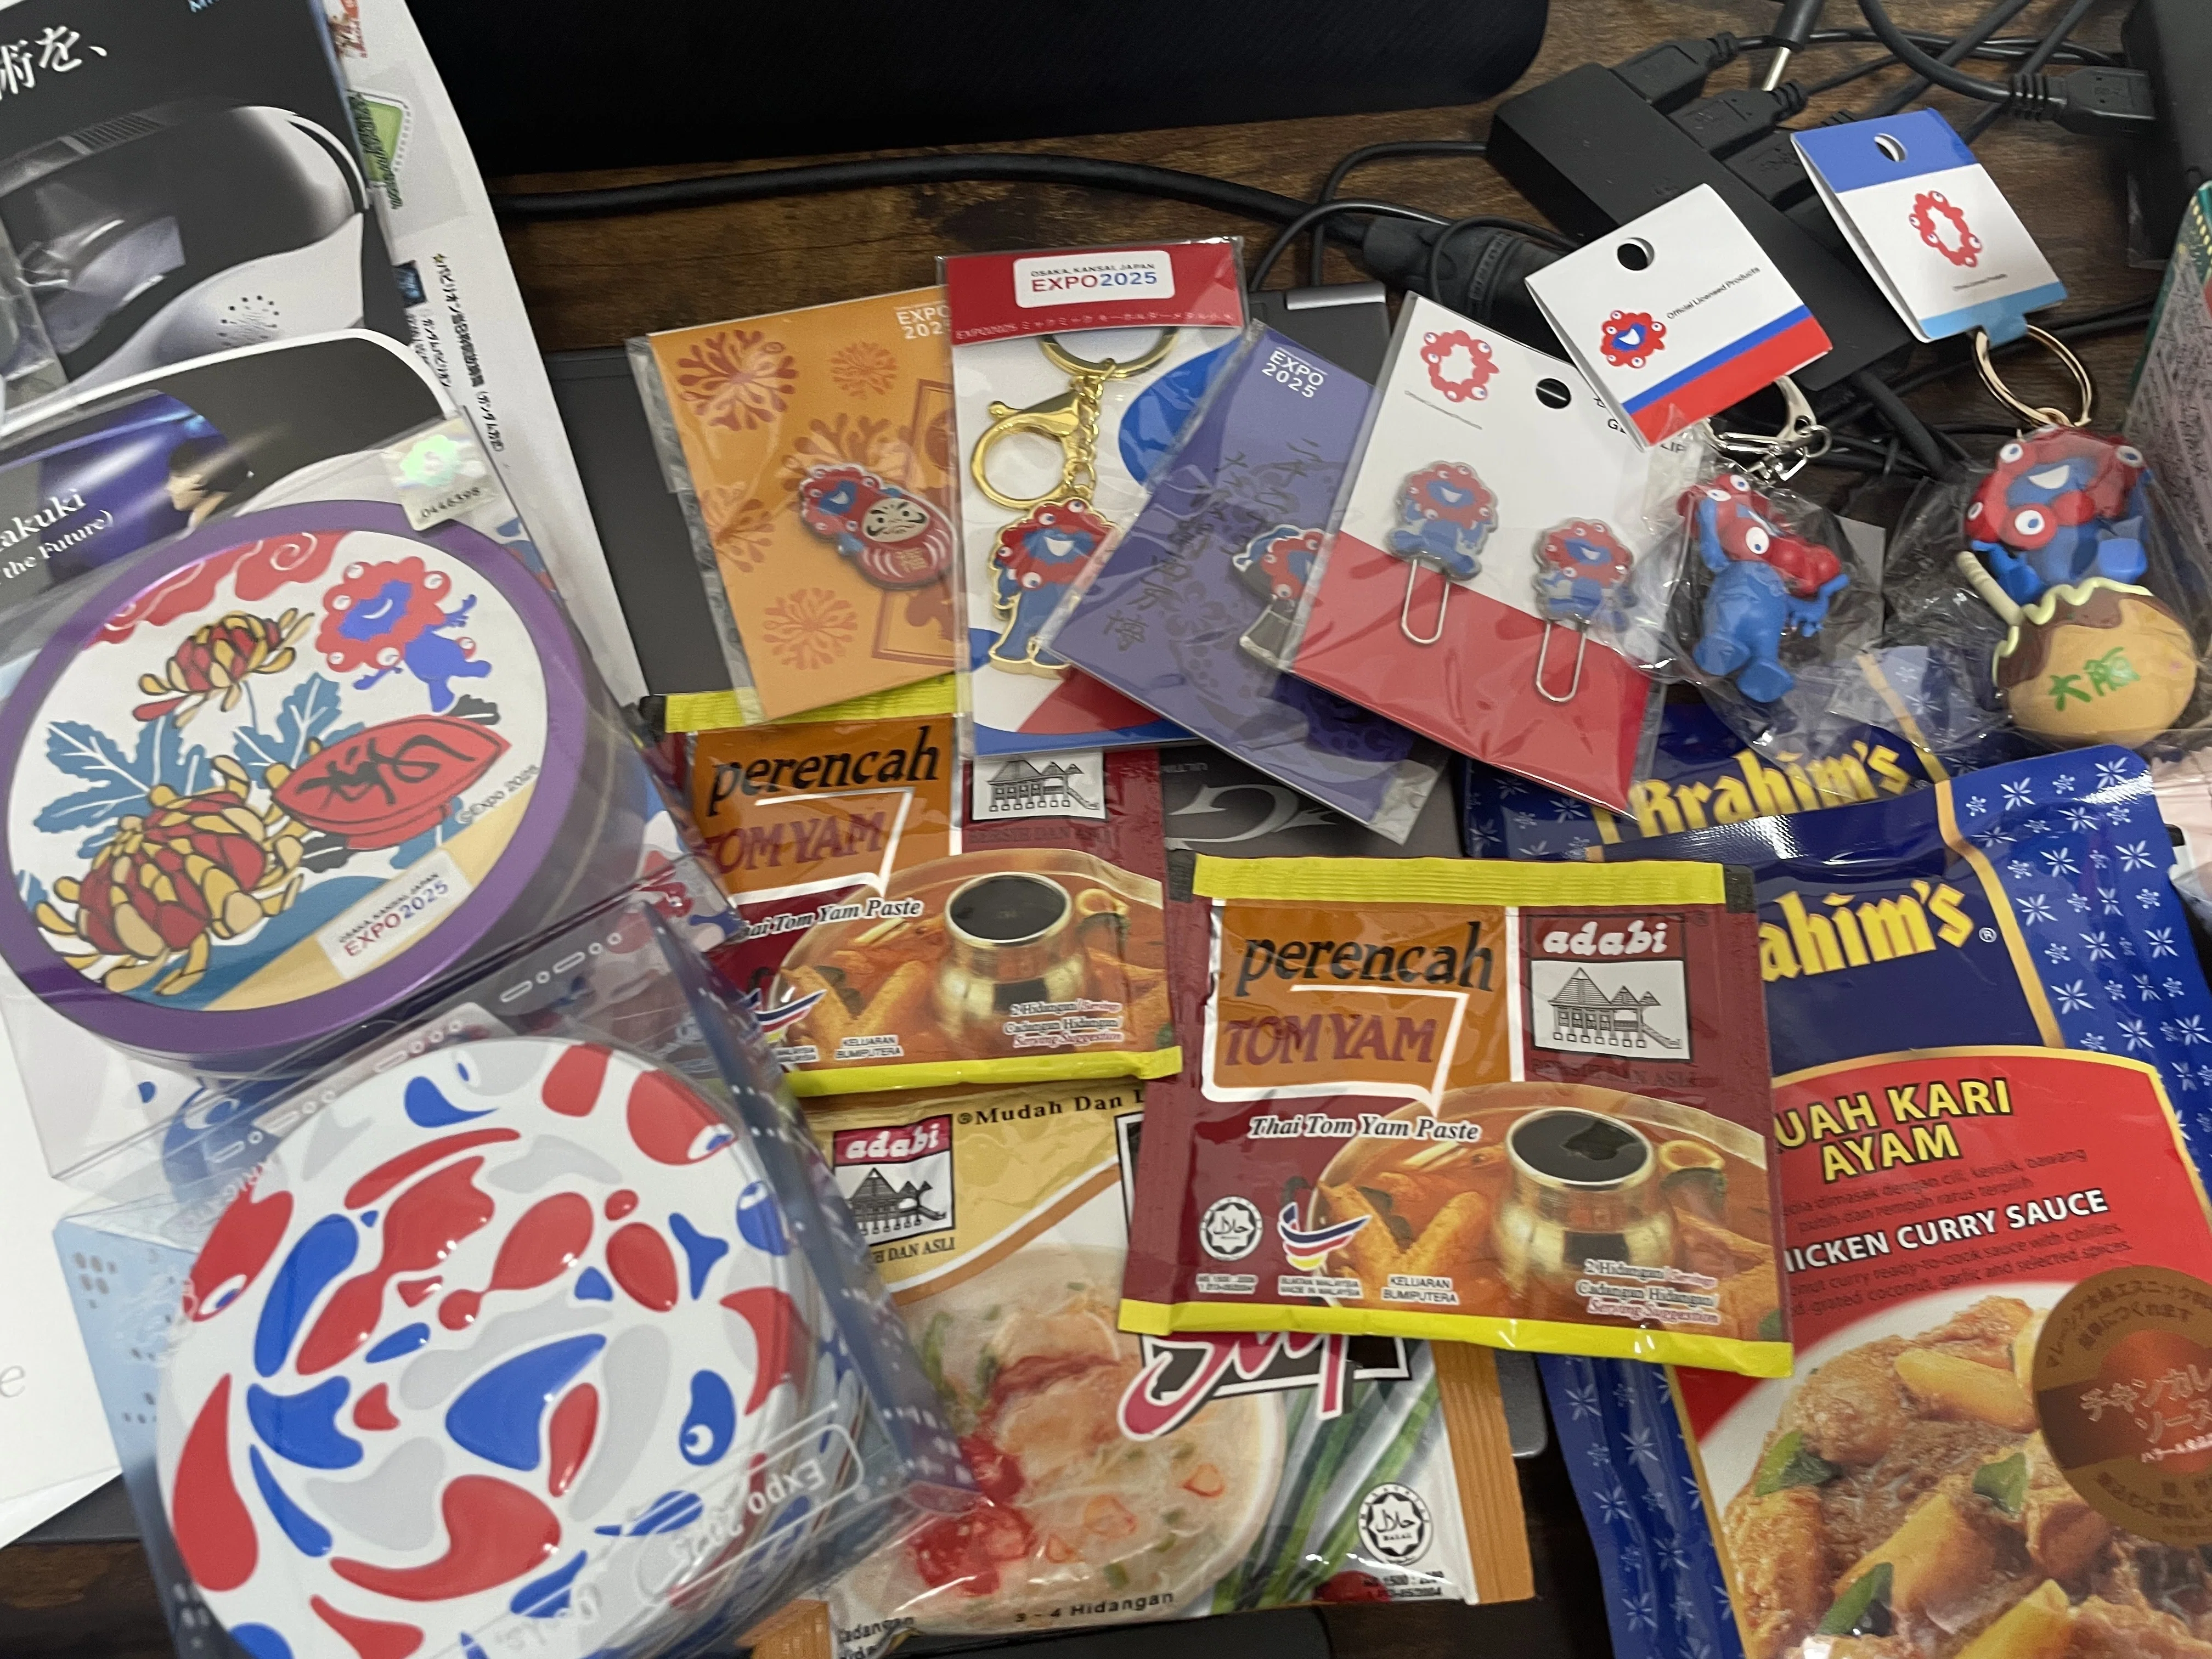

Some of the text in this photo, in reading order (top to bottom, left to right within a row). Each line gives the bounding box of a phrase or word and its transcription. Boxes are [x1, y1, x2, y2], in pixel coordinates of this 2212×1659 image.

[1031, 272, 1158, 293] EXPO2025
[1120, 263, 1154, 272] JAPAN
[1692, 283, 1726, 306] Licensed
[1725, 266, 1760, 290] Products
[896, 304, 951, 325] EXPO
[902, 319, 950, 340] 202
[1262, 363, 1317, 398] 2025
[1269, 350, 1325, 386] EXPO
[3, 510, 114, 578] the Future)
[707, 725, 939, 817] perencah
[782, 810, 885, 866] YAM
[342, 877, 452, 958] EXPO2025
[742, 898, 923, 938] hai Tom Yam Paste
[1543, 920, 1668, 956] adabi
[1235, 922, 1493, 997] perencah
[1224, 1014, 1439, 1065] TOM YAM
[975, 1102, 1063, 1125] Mudah
[1074, 1095, 1122, 1112] Dan
[1252, 1115, 1479, 1140] Thai Tom Yam Paste
[1776, 1077, 2012, 1149] UAH KARI
[845, 1123, 940, 1159] adabi
[1821, 1122, 1961, 1183] AYAM
[1896, 1210, 1996, 1250] CURRY
[2005, 1189, 2109, 1229] SAUCE
[888, 1244, 919, 1262] DAN
[923, 1237, 955, 1255] ASLI
[1383, 1290, 1456, 1303] BUMIPUTERA
[1391, 1277, 1450, 1289] KELUARAN
[748, 1458, 826, 1515] Expo
[1070, 1592, 1173, 1616] Hidangan
